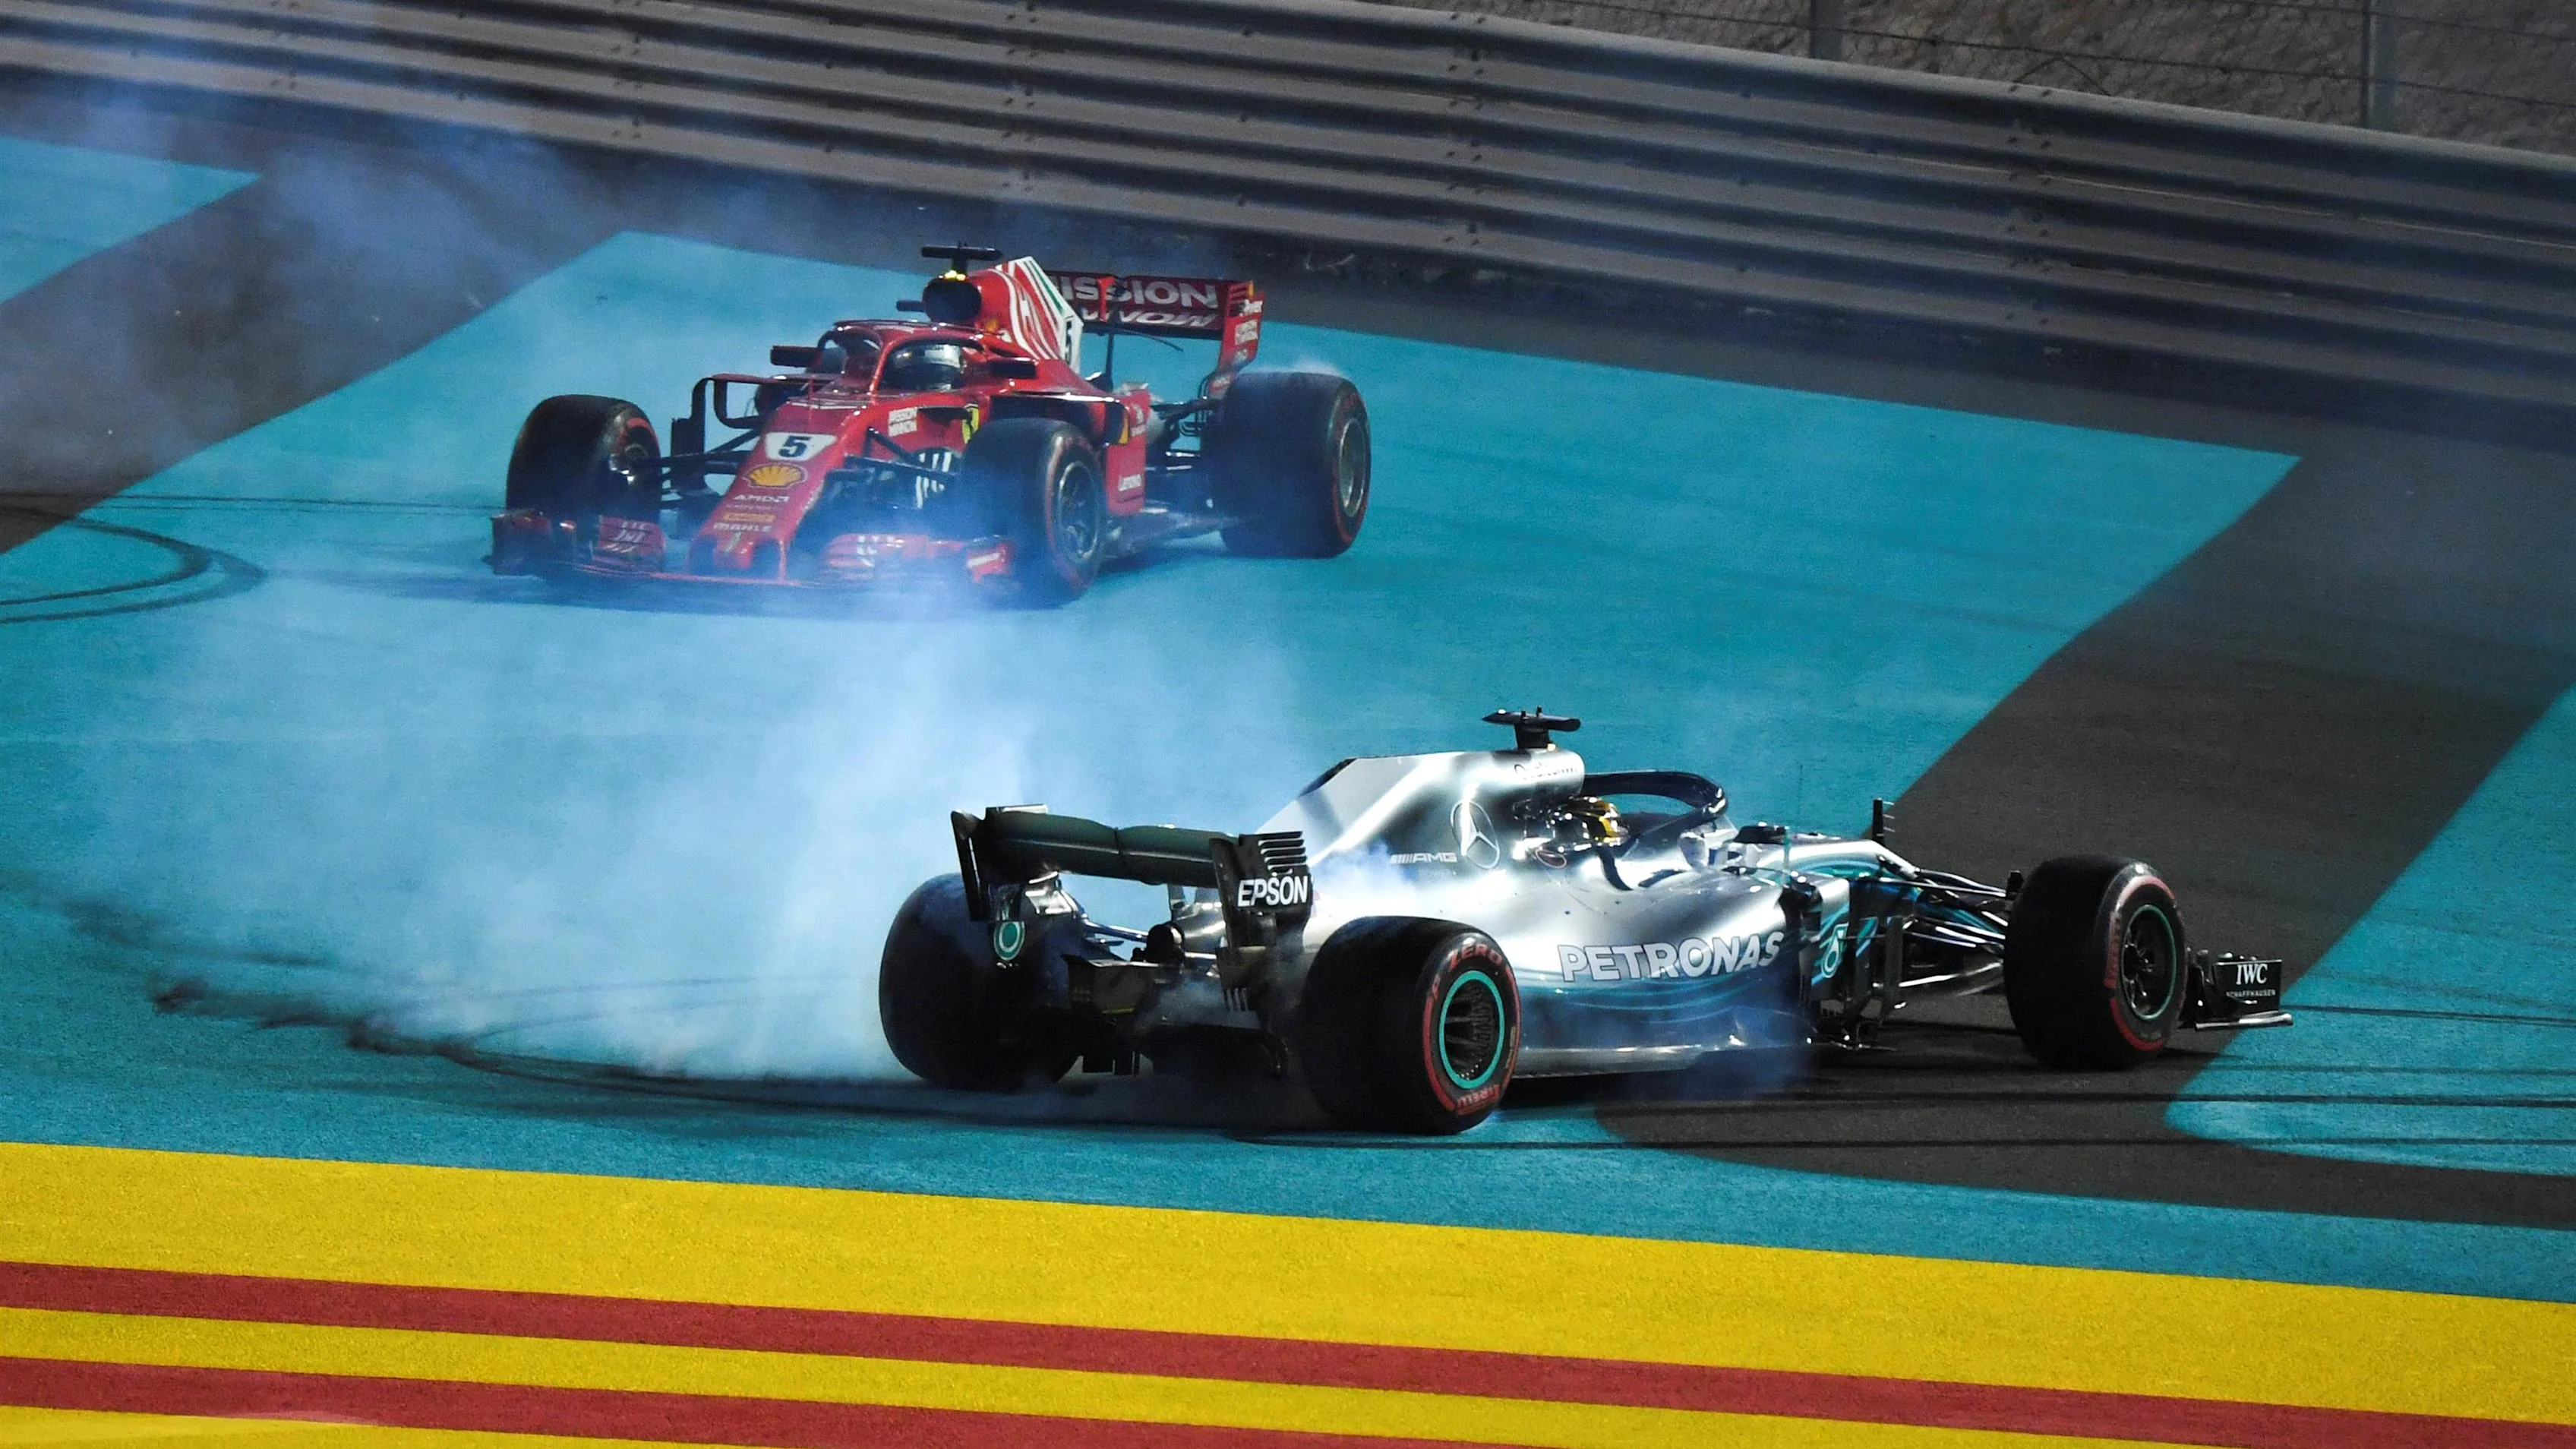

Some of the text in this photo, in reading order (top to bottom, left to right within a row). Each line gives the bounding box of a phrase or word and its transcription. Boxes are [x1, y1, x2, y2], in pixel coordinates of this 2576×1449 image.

[1058, 276, 1219, 308] ISSION
[778, 435, 812, 458] 5
[1413, 852, 1457, 863] AMG
[1237, 876, 1309, 908] EPSON
[1448, 944, 1504, 971] ZERO
[1557, 931, 1785, 983] PETRONAS
[2236, 963, 2268, 986] IWC
